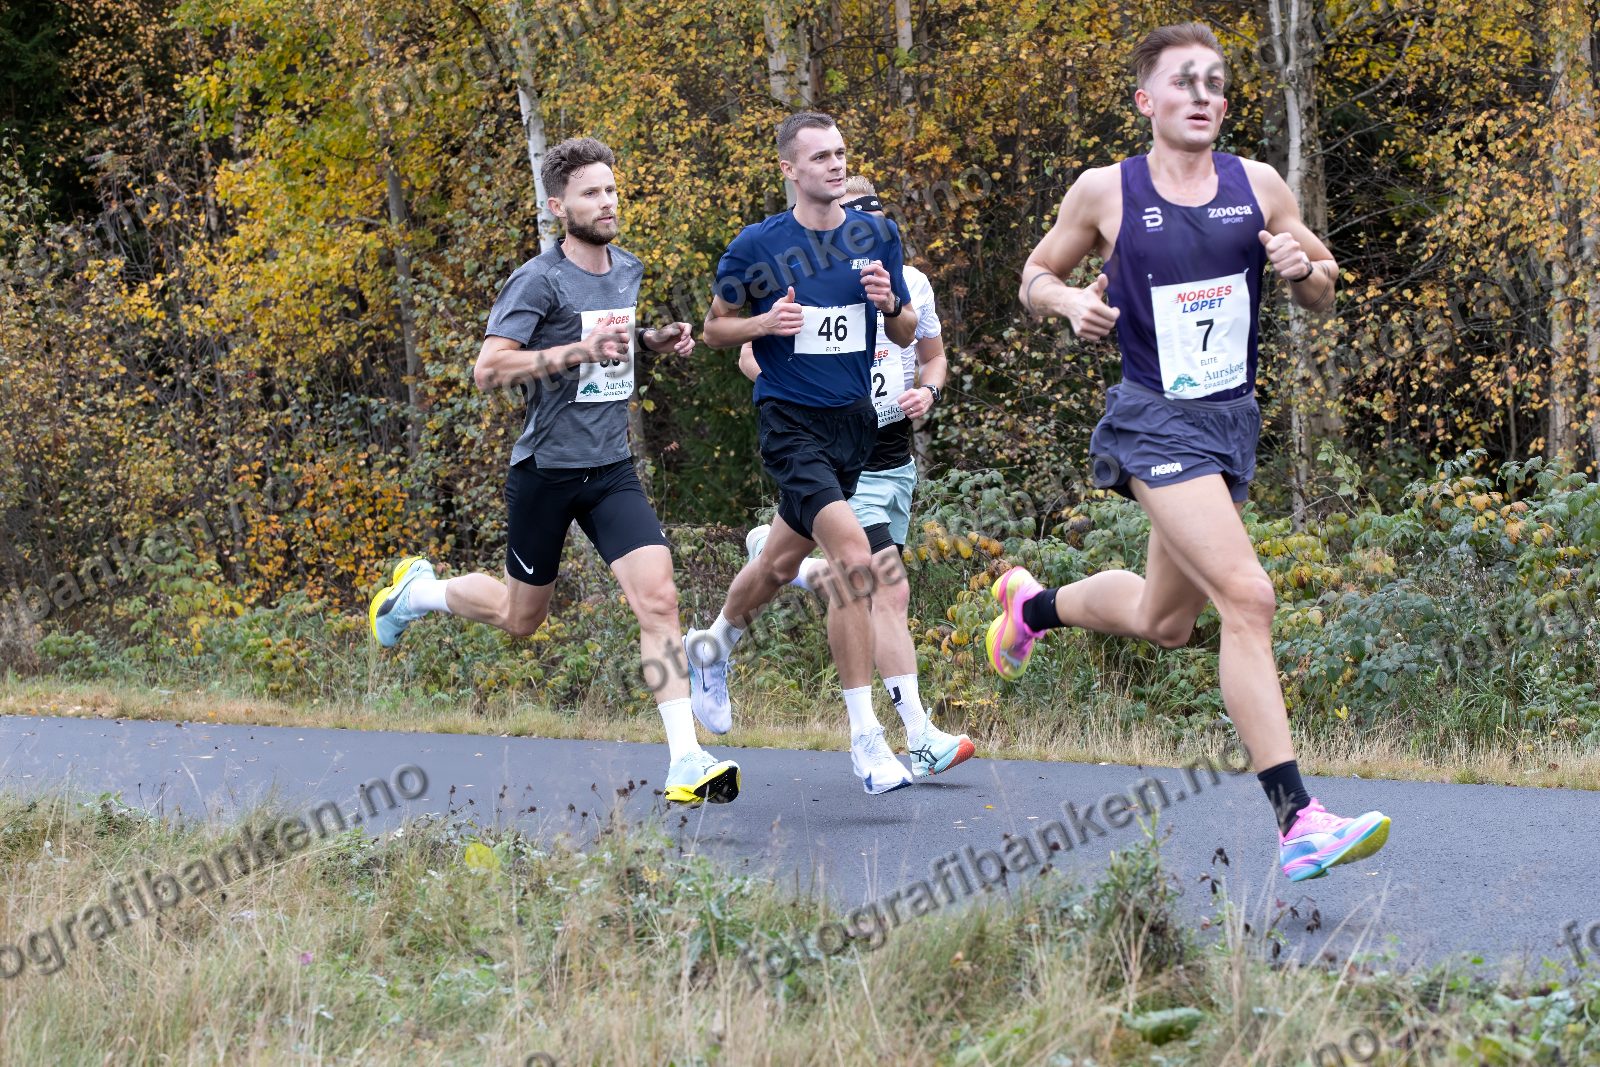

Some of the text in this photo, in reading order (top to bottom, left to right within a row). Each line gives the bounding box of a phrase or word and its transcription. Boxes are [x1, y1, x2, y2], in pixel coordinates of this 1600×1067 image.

[1208, 204, 1252, 218] zooca
[1176, 285, 1232, 302] NORGES
[1182, 297, 1225, 313] LØPET
[818, 315, 848, 341] 46
[1196, 318, 1214, 352] 7
[1200, 357, 1218, 366] ELITE
[1203, 361, 1244, 381] Aurskog
[873, 373, 888, 398] 2
[1151, 462, 1182, 476] HOKA
